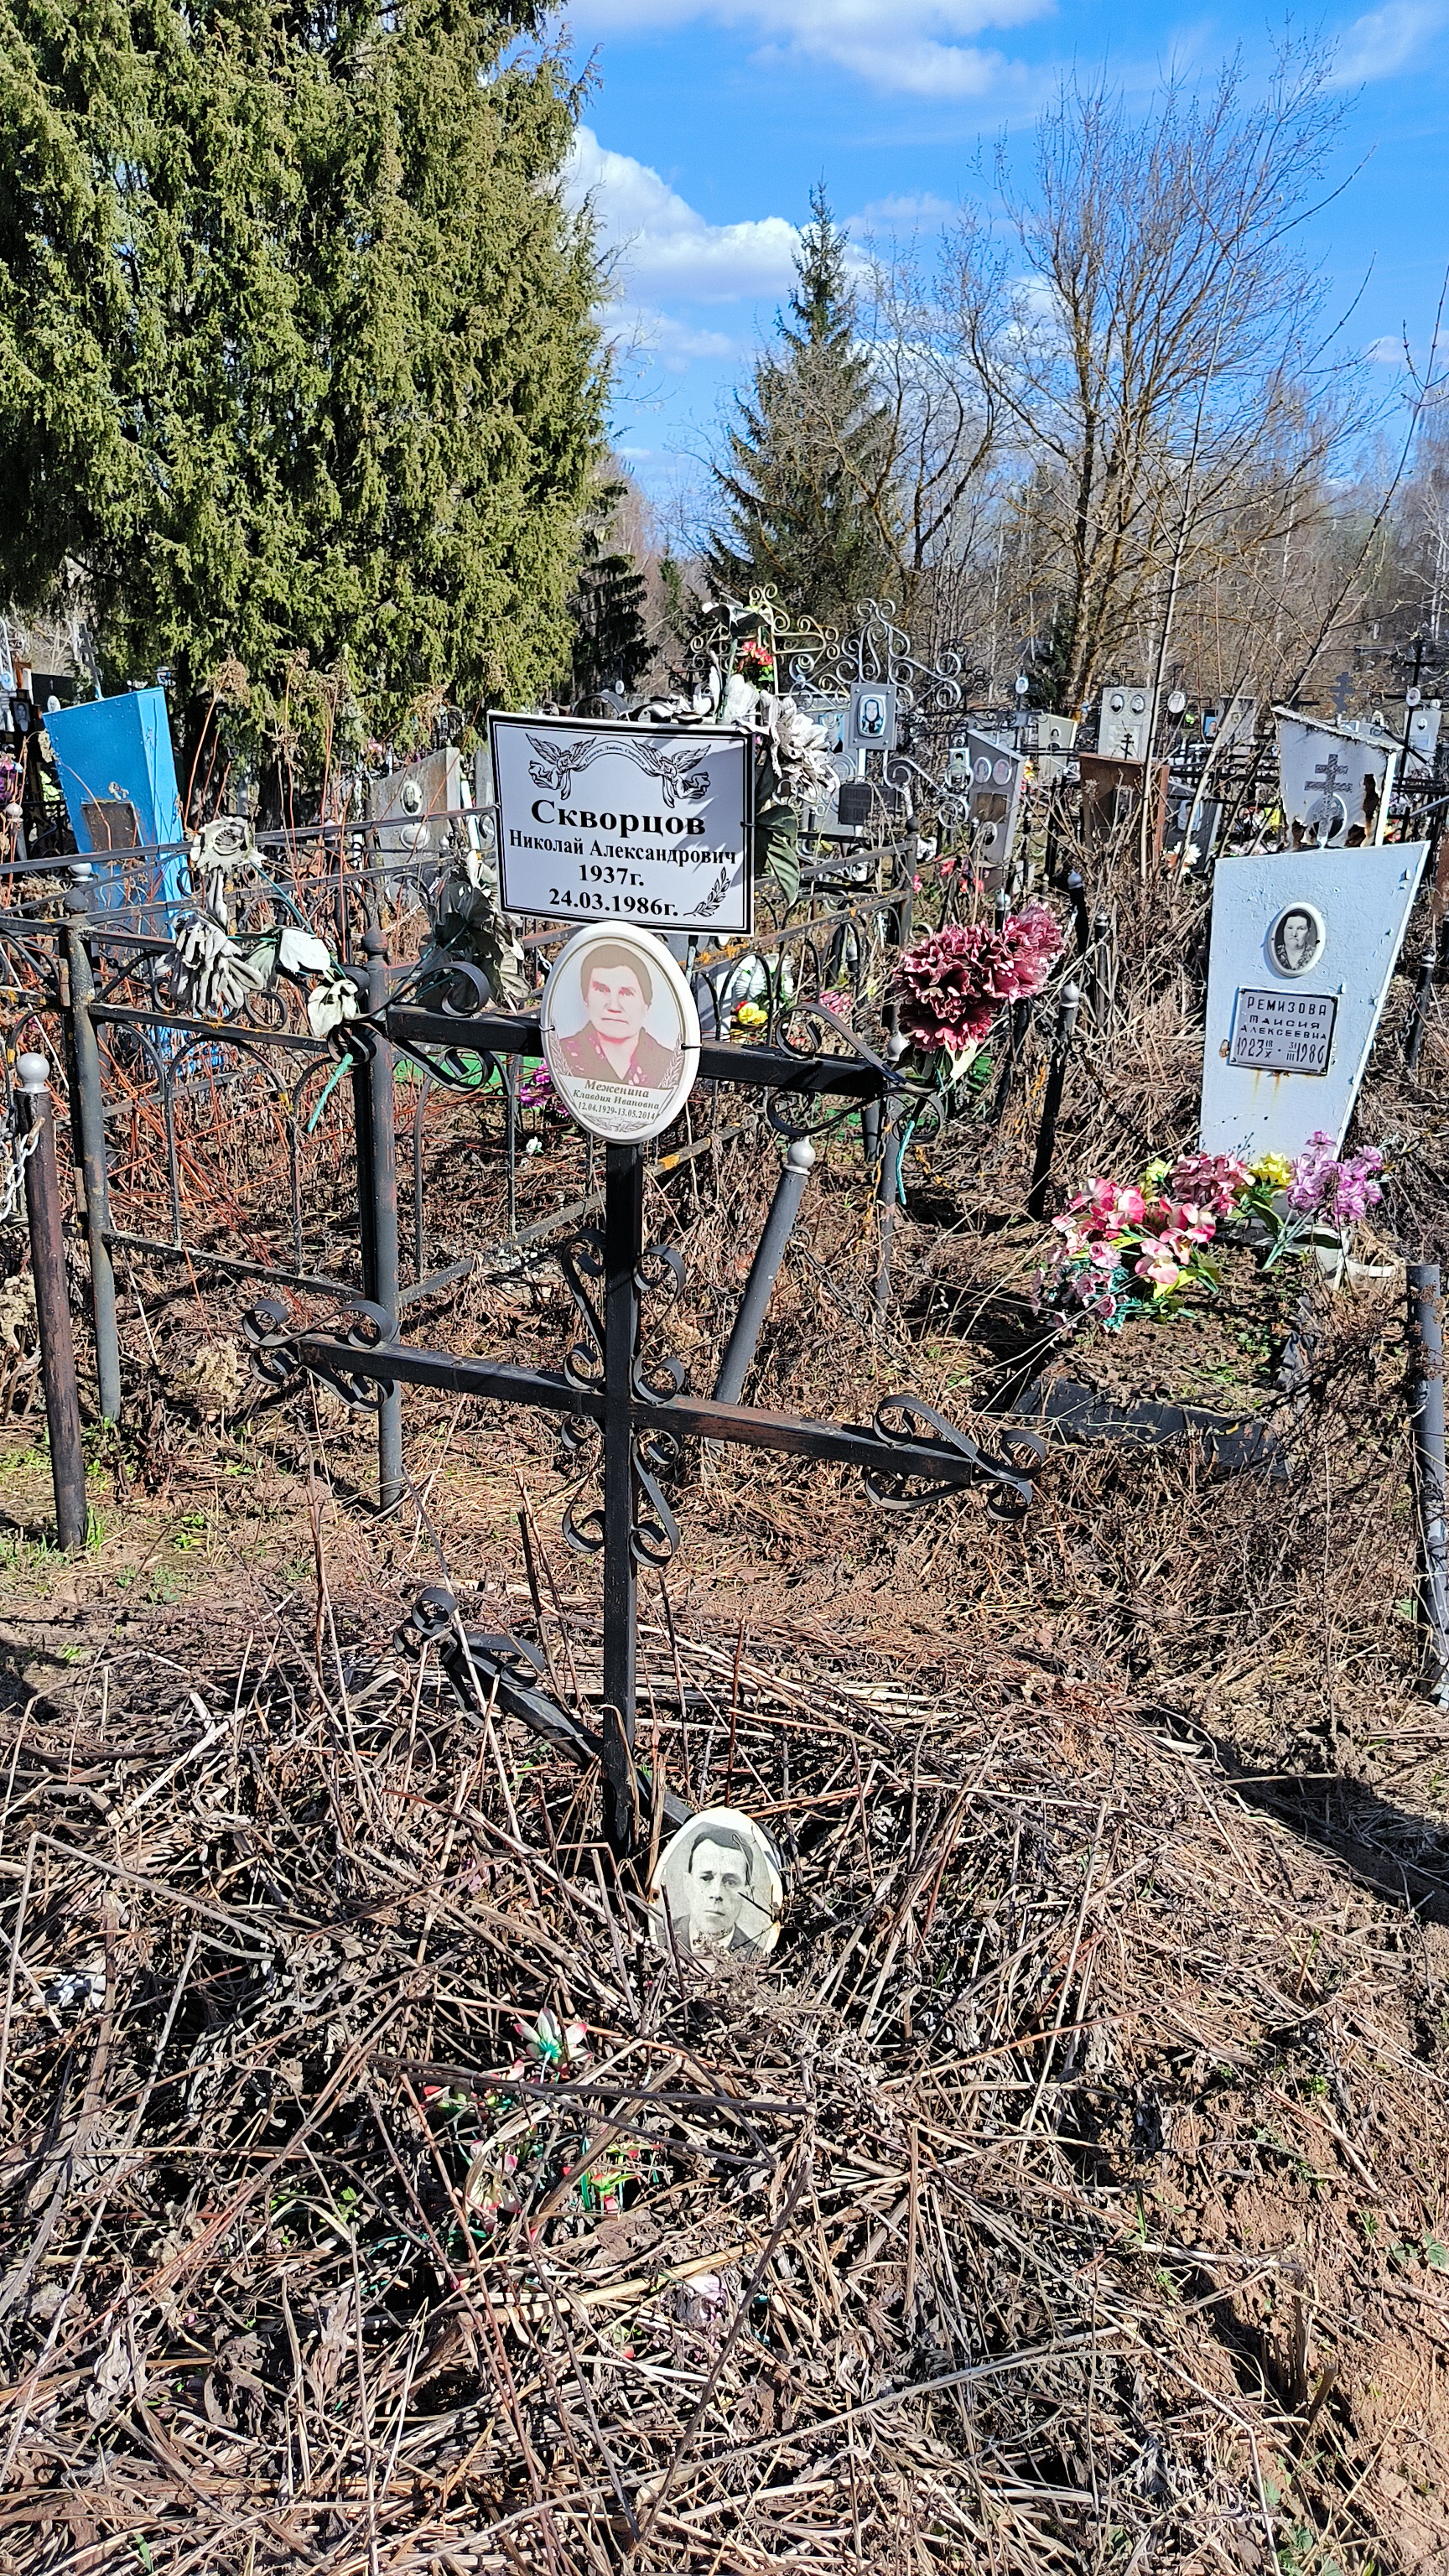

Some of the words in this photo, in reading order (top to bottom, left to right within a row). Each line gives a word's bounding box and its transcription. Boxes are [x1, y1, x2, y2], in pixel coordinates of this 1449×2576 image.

[531, 799, 706, 839] Скворцов
[509, 829, 584, 855] Николай
[589, 839, 736, 867] Александрович
[579, 864, 645, 886] 1937г.
[548, 888, 678, 917] 24.03.1986г.
[1247, 996, 1327, 1016] РЕМИЗОВА
[1240, 1025, 1327, 1041] АЛЕКСЕЕВНА
[1249, 1015, 1320, 1030] ТАИСИЯ
[1236, 1036, 1264, 1057] 1923
[1296, 1042, 1326, 1064] 1986
[584, 1079, 650, 1098] Меженина
[573, 1089, 611, 1103] Клавдия
[614, 1096, 659, 1110] Ивановна
[578, 1101, 656, 1120] 12.04.1929-13.05.2014
